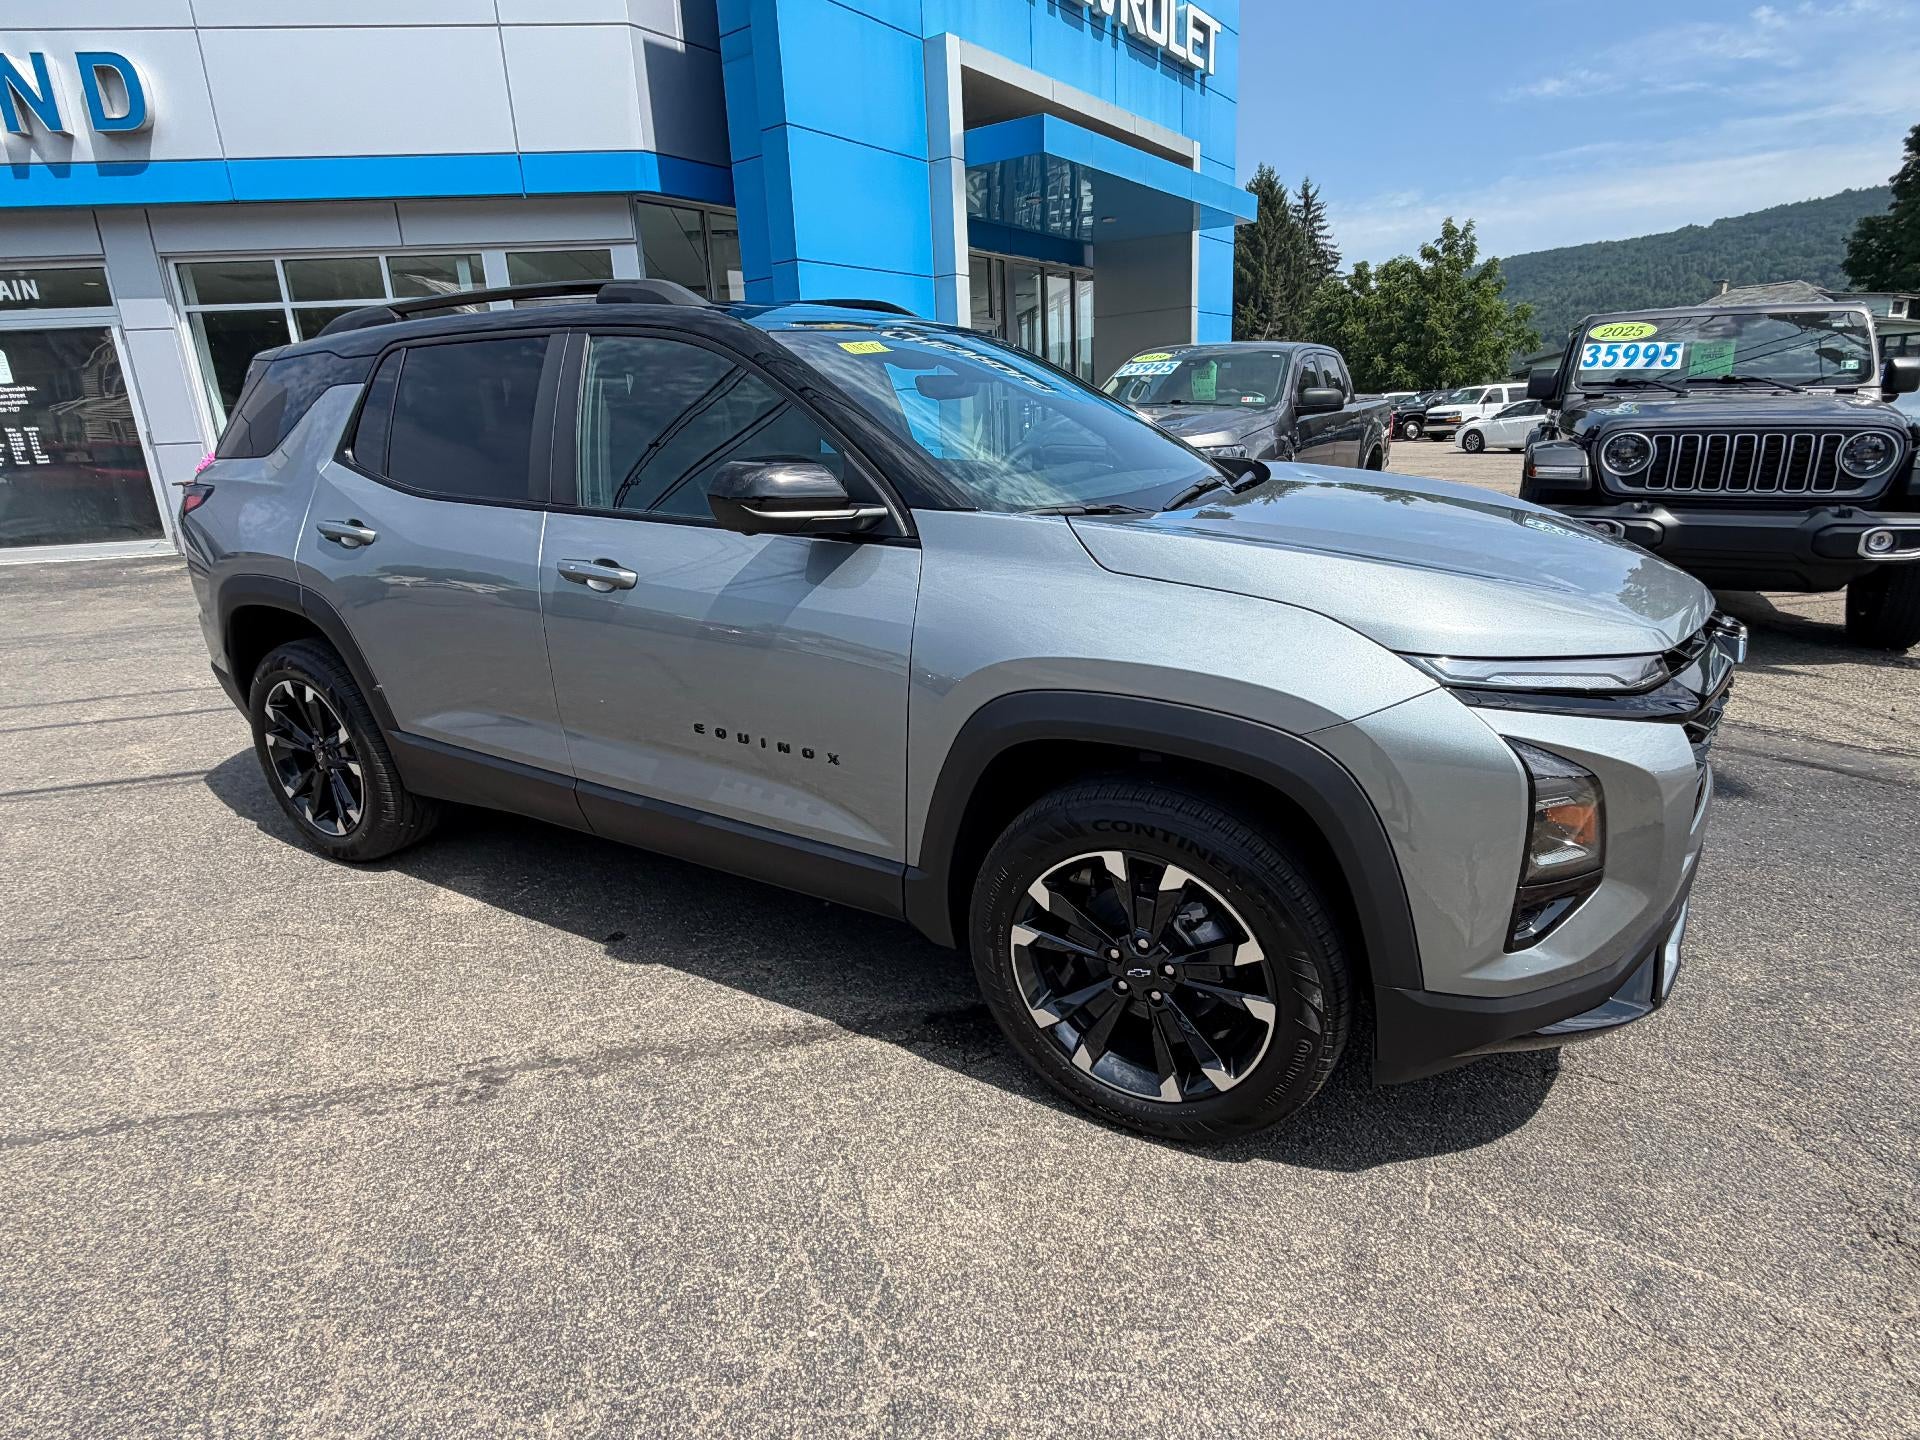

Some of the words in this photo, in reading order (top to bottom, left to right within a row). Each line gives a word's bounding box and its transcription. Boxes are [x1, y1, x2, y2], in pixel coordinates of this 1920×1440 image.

[1600, 325, 1645, 338] 2025
[1582, 343, 1682, 368] 35995
[1118, 362, 1178, 375] 23995
[693, 722, 840, 766] EQUINOX
